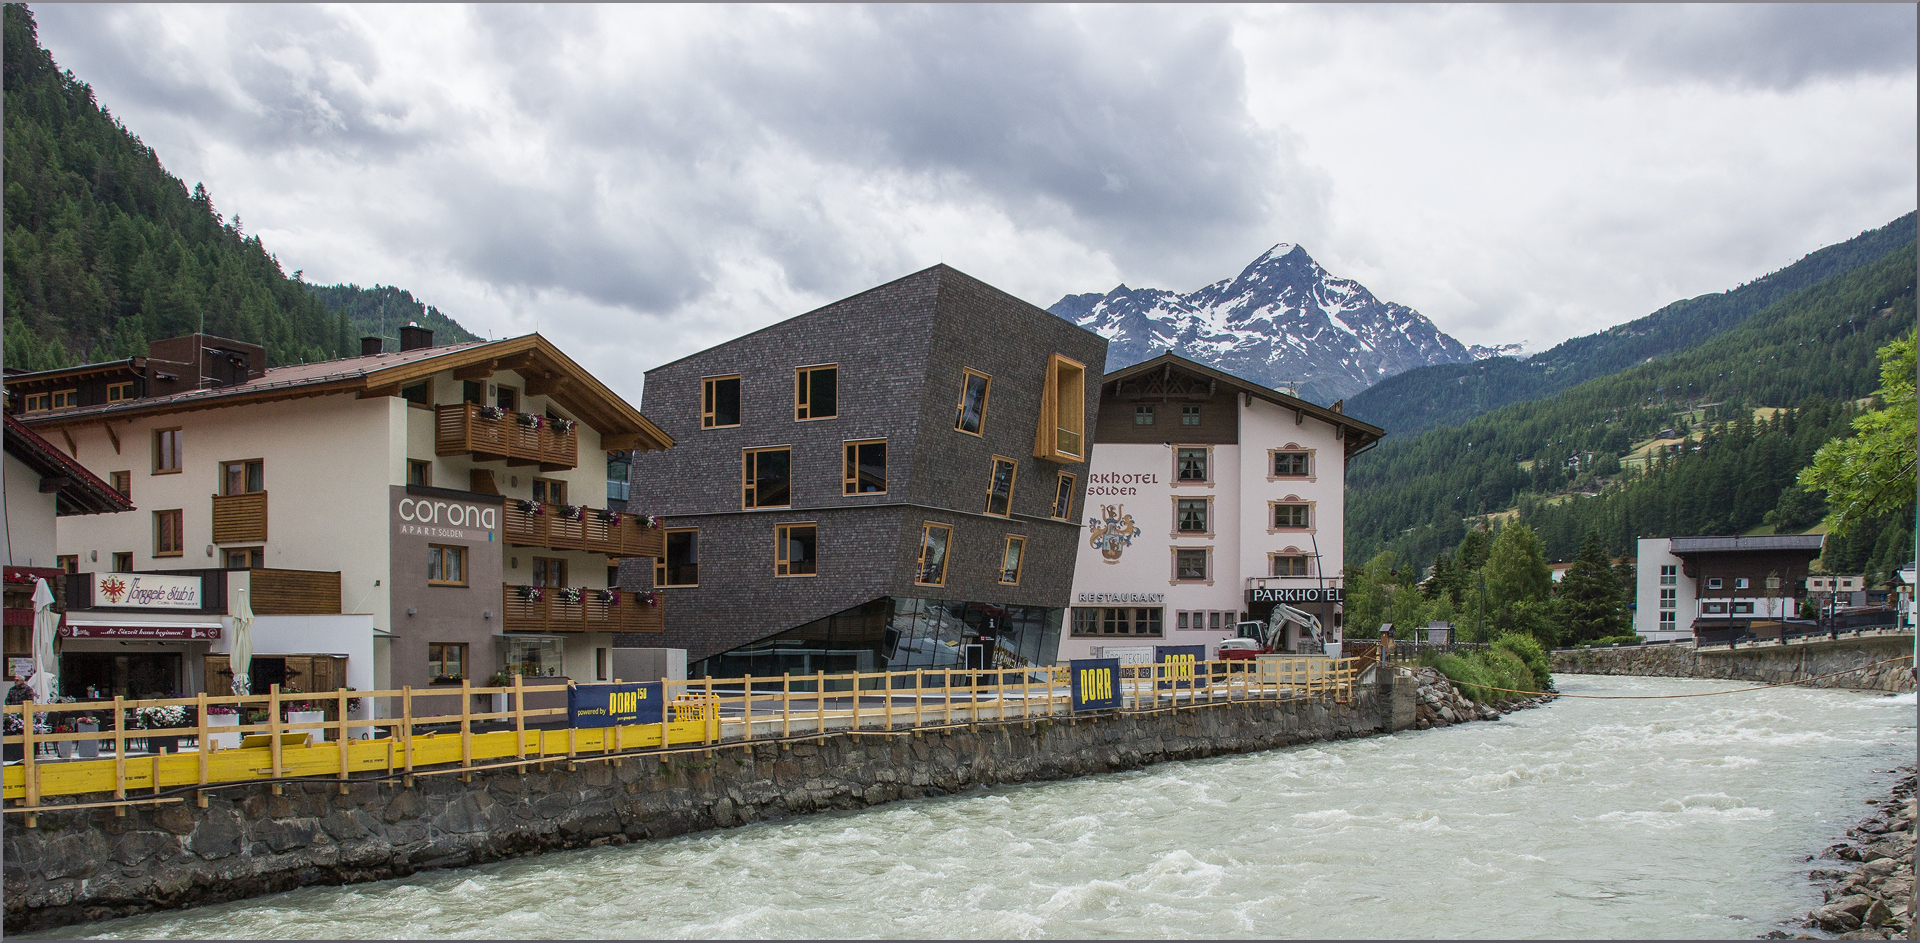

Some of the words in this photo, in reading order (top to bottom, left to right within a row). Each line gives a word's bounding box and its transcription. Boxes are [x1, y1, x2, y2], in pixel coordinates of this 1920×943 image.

[398, 498, 495, 529] corona
[1078, 593, 1165, 602] RESTAURANT
[1080, 668, 1112, 704] PORR
[577, 708, 599, 717] powered
[599, 708, 606, 716] by
[609, 691, 636, 716] PORR
[637, 687, 647, 700] 150
